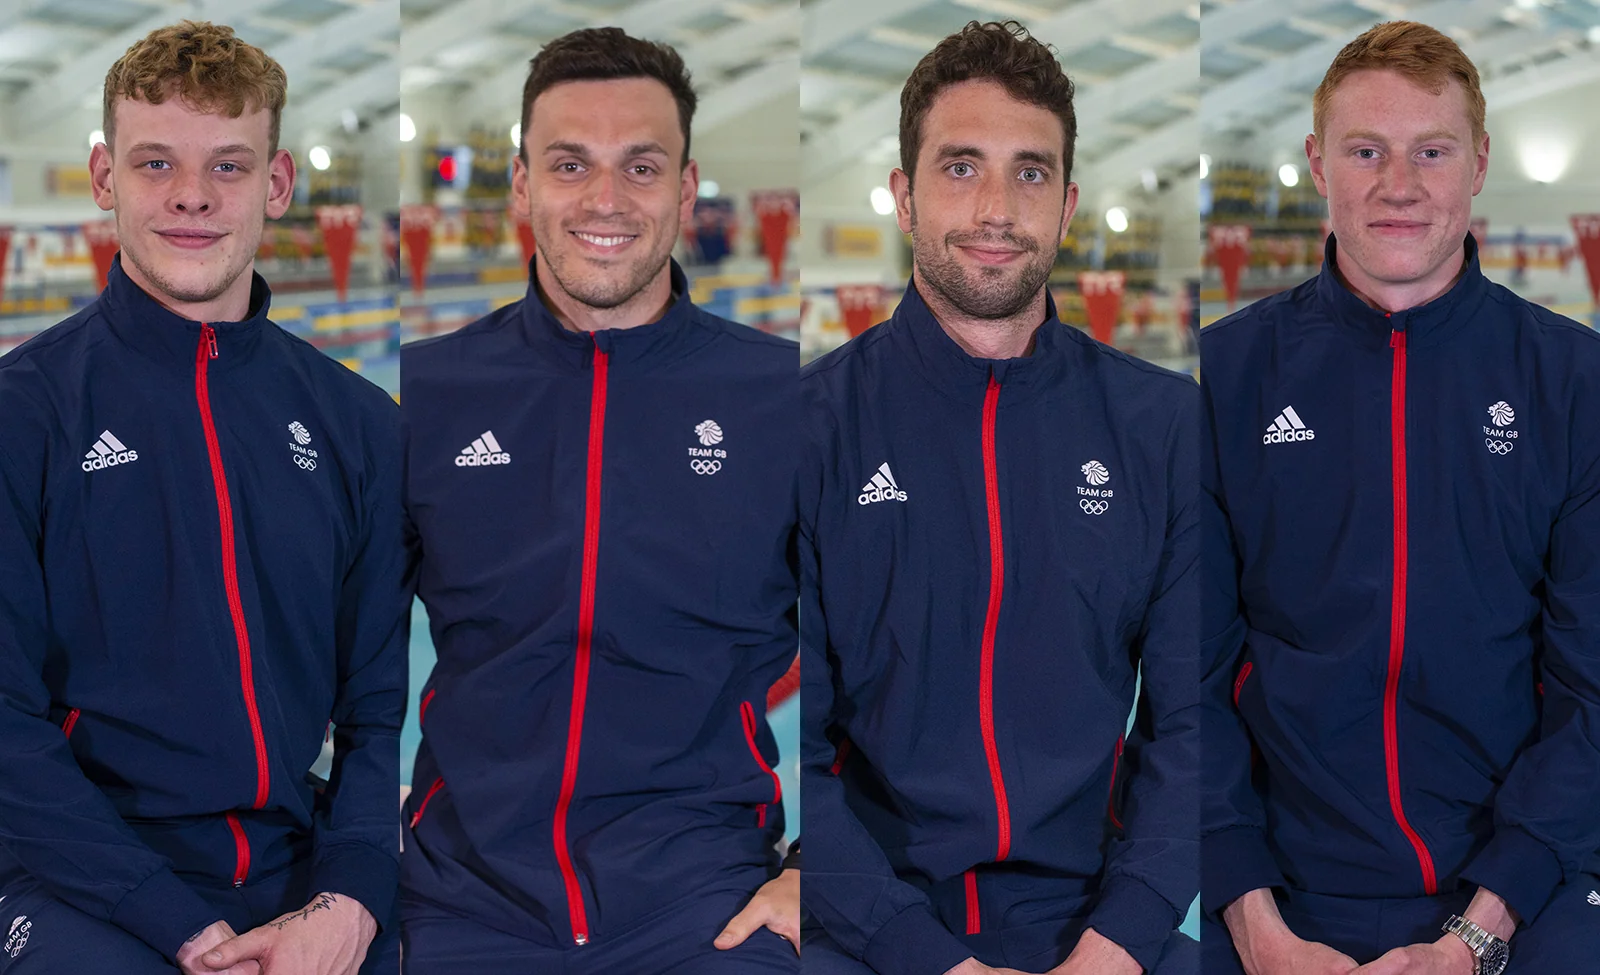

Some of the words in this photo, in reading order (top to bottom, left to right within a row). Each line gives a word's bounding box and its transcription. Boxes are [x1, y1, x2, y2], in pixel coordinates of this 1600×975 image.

[1263, 427, 1315, 445] adidas
[1483, 426, 1505, 438] TEAM
[1506, 431, 1519, 439] GB
[289, 443, 307, 455] TEAM
[308, 449, 318, 458] GB
[687, 448, 712, 458] TEAM
[714, 448, 727, 459] GB
[81, 450, 138, 471] adidas
[455, 451, 511, 467] adidas
[857, 486, 908, 505] adids
[1077, 486, 1099, 498] TEAM
[1101, 489, 1114, 498] GB
[4, 930, 21, 953] TEAM
[20, 920, 33, 933] GB
